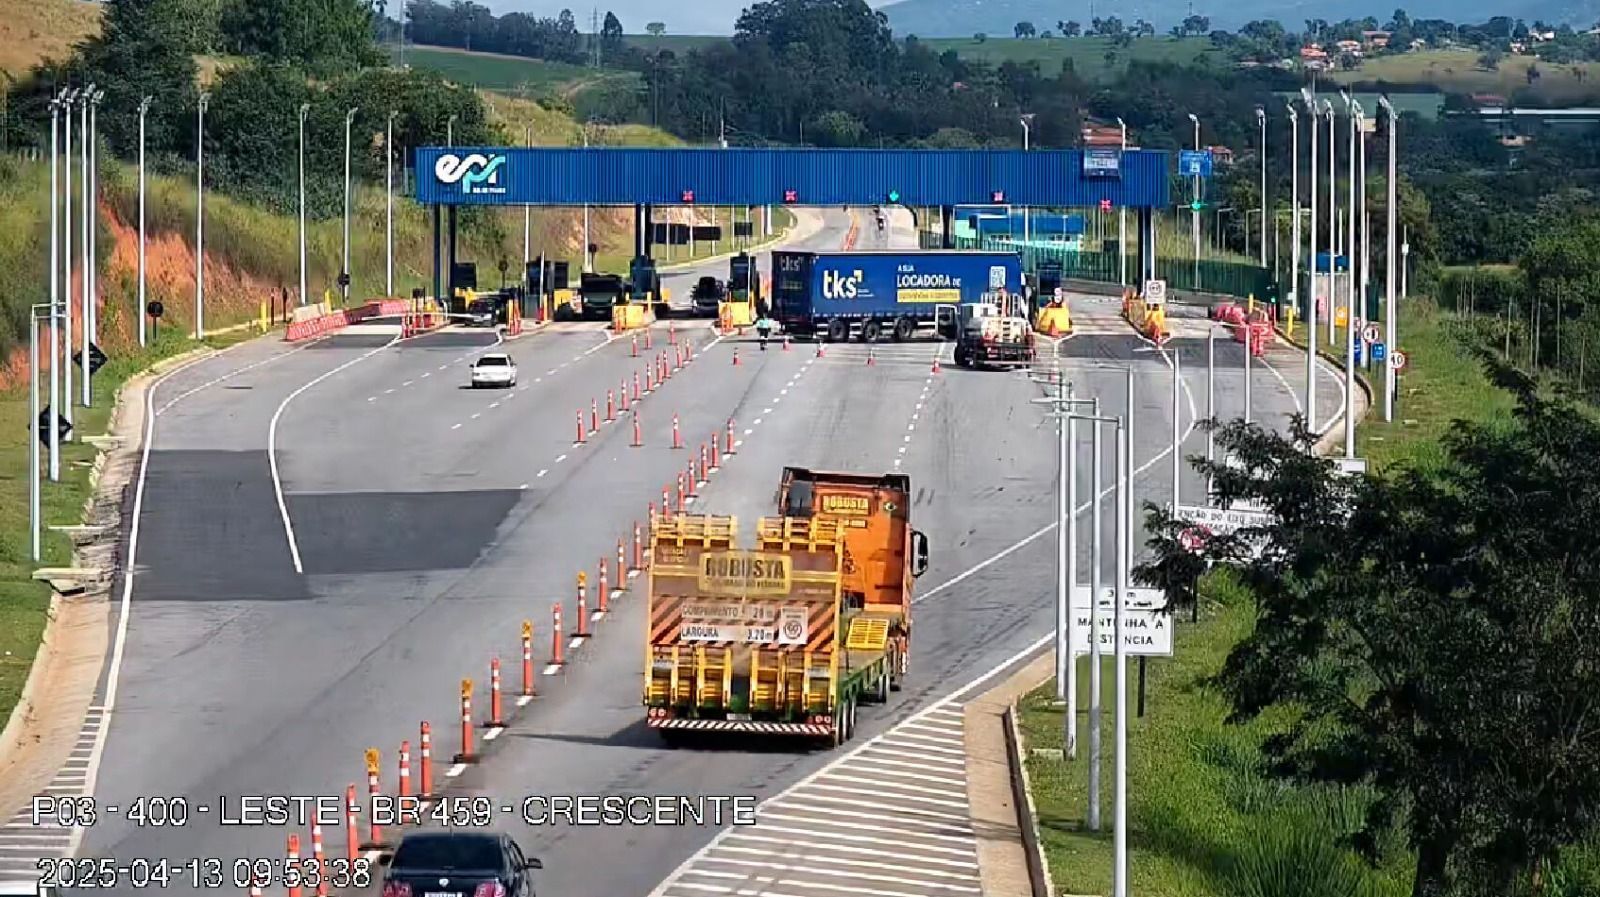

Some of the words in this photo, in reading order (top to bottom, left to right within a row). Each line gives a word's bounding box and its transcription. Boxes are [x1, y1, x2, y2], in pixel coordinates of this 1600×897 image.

[823, 269, 857, 299] tks
[897, 274, 951, 288] LOCADORA
[705, 557, 785, 579] ROBUSTA
[1156, 619, 1164, 629] A
[681, 625, 719, 638] LARGURA
